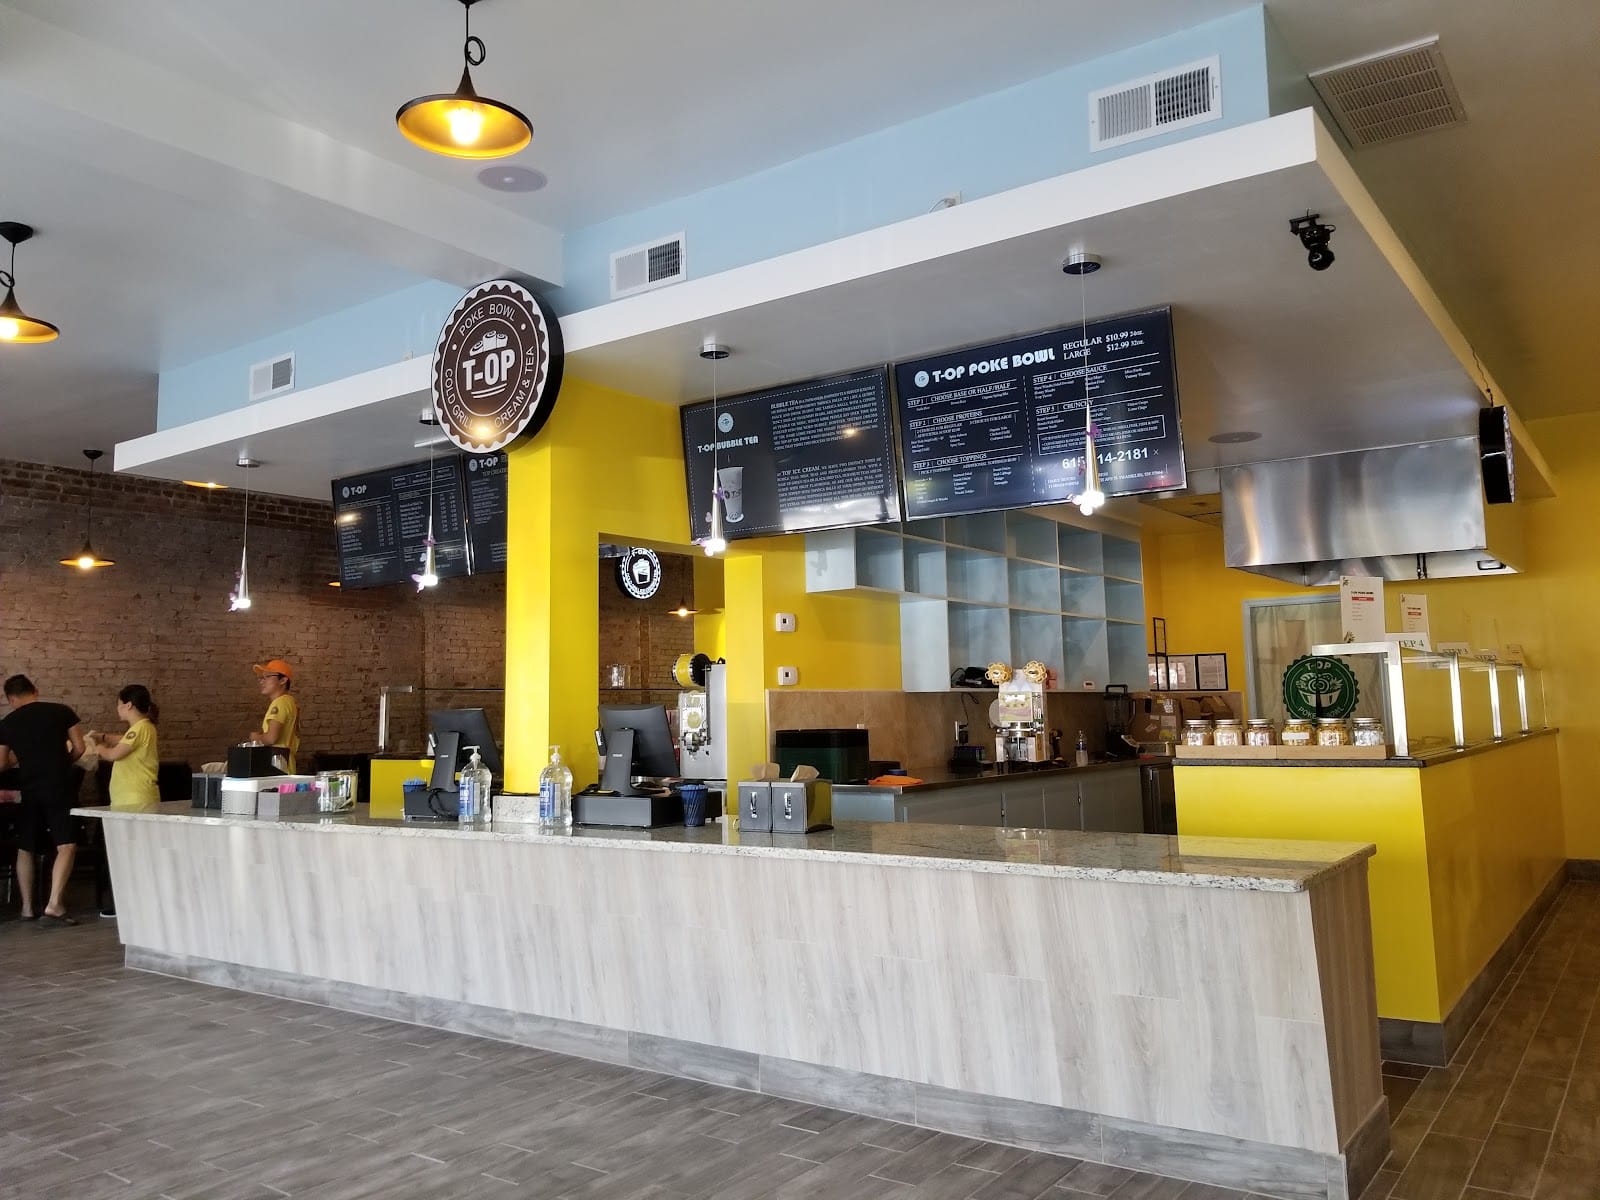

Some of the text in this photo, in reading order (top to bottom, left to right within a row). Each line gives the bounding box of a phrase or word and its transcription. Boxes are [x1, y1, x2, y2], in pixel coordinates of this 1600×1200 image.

[458, 303, 516, 337] POKE BOWL
[1062, 336, 1103, 351] REGULAR
[1105, 331, 1129, 343] $10.99
[1063, 348, 1092, 360] LARGE
[1106, 340, 1130, 352] $12.99
[462, 349, 516, 391] T-OP
[931, 347, 1056, 383] T-OP POKE BOWL
[1032, 375, 1048, 384] STEP
[1059, 369, 1086, 379] CHOOSE
[1086, 365, 1108, 375] SAUCE
[444, 368, 456, 404] COLD
[494, 345, 535, 429] CREAM & TEA
[907, 399, 921, 408] STEP
[930, 393, 953, 403] CHOOSE
[976, 383, 1011, 395] HALF/HALF
[909, 421, 923, 430] STEP
[932, 415, 956, 425] CHOOSE
[955, 410, 983, 421] PROTEINS
[1035, 406, 1051, 415] STEP
[697, 434, 759, 454] T-OP BUBBLE TEA
[478, 456, 499, 469] T-OP
[913, 462, 927, 470] STEP
[936, 458, 959, 467] CHOOSE
[959, 453, 987, 464] TOPPINGS
[350, 484, 368, 496] T-OP
[1297, 706, 1317, 720] POKE
